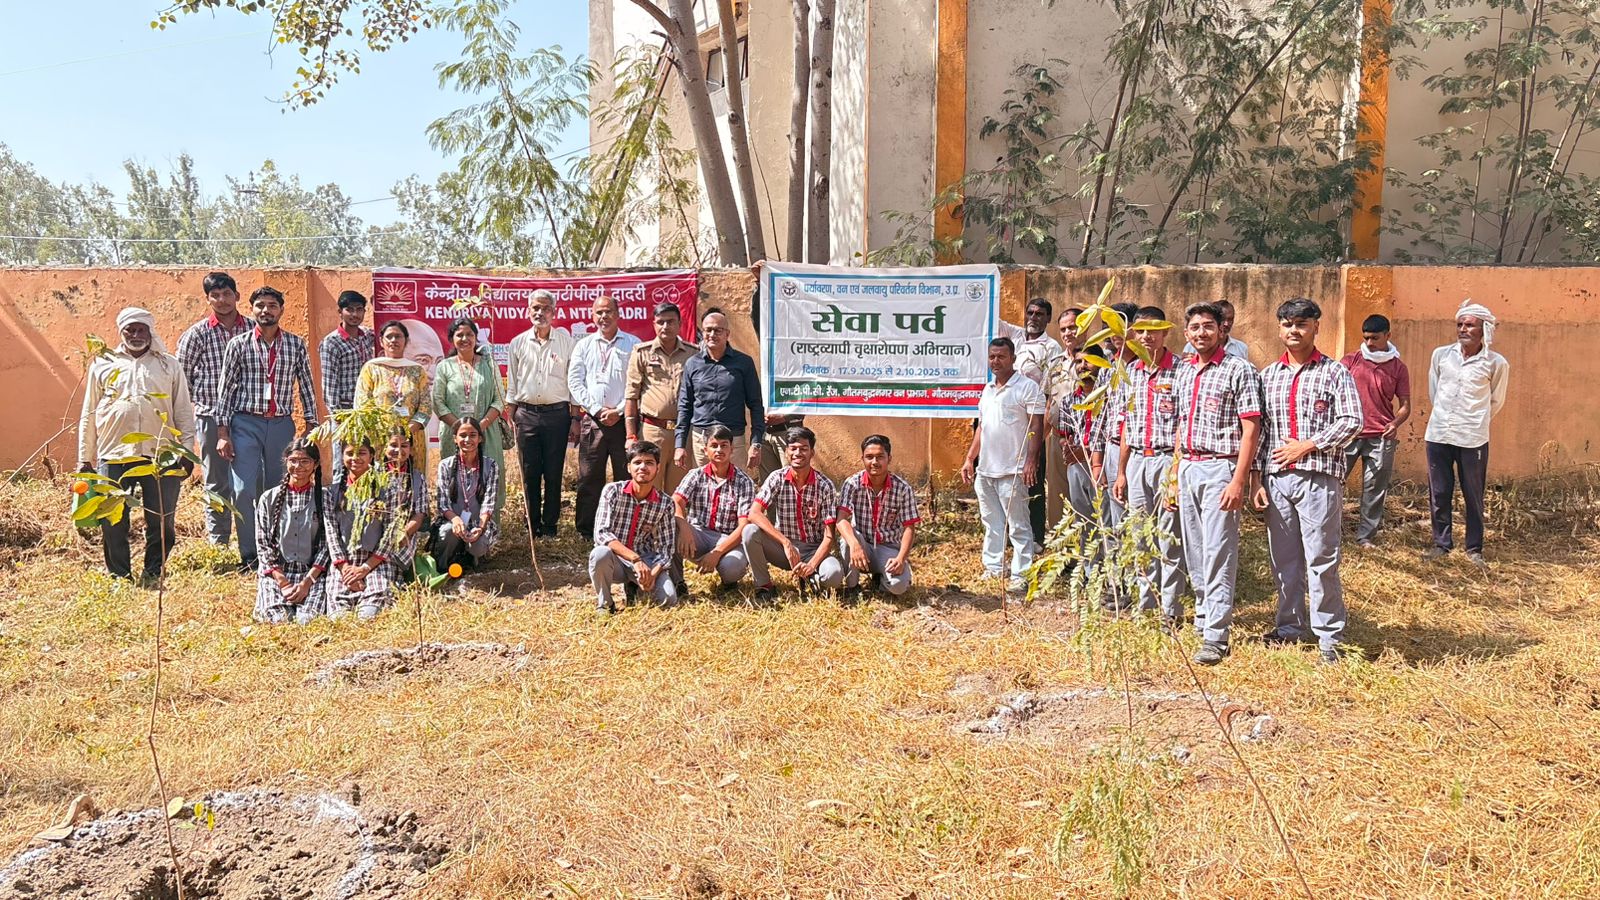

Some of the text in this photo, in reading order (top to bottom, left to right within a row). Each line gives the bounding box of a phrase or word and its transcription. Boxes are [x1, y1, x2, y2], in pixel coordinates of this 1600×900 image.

[424, 282, 472, 300] केन्द्रीय
[551, 284, 606, 301] नटीपीसी
[611, 283, 646, 301] दादरी
[836, 284, 848, 294] वन
[850, 283, 860, 294] एवं
[861, 284, 888, 297] जलवायु
[889, 281, 917, 295] परिवर्तन
[425, 305, 492, 319] KENDRIYA
[618, 307, 647, 319] ADRI
[810, 304, 947, 334] सेवा पर्व
[790, 340, 972, 359] (राष्ट्रव्यापी वृक्षारोपण अभियान)
[802, 364, 830, 375] दिनांक
[838, 367, 883, 376] 17.9.2025
[885, 365, 893, 375] से
[896, 367, 941, 376] 2.10.2025
[943, 367, 960, 376] तक
